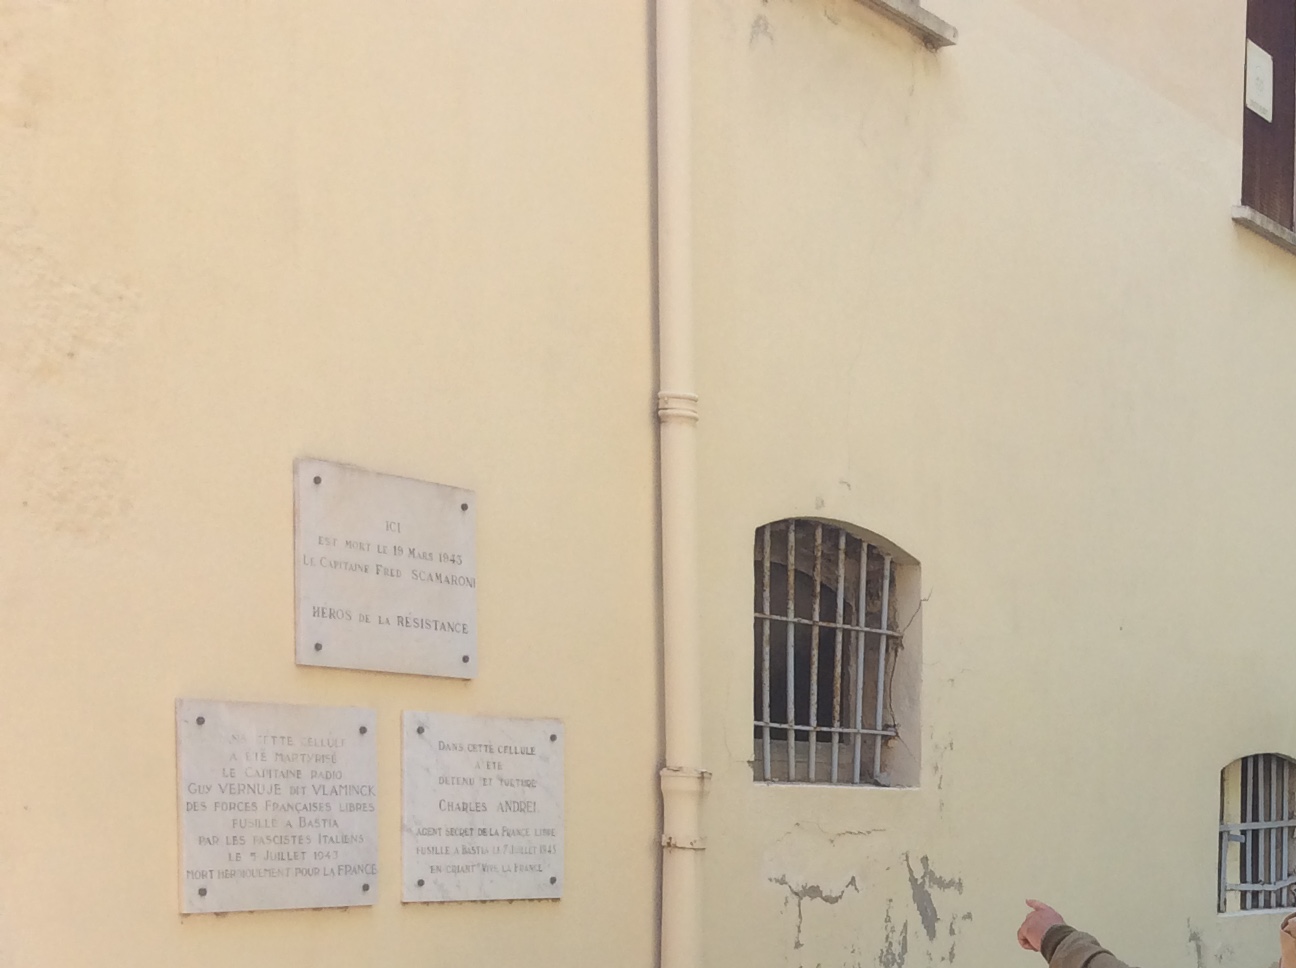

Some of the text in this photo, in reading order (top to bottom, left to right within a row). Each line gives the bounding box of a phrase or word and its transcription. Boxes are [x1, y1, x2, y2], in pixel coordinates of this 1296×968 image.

[385, 520, 401, 533] ICI
[318, 536, 337, 547] EST
[345, 540, 370, 552] MORT
[377, 545, 388, 554] LE
[393, 545, 404, 556] 19
[303, 554, 316, 566] LE
[320, 557, 370, 574] CAPITAINE
[411, 569, 476, 589] SCAMARONI
[359, 613, 371, 623] DE
[378, 615, 391, 625] LA
[438, 740, 536, 755] DANS CETTE CELLULE
[222, 769, 235, 778] LE
[311, 770, 343, 780] RADIO
[290, 786, 306, 795] DIT
[312, 785, 376, 796] VLAMINCK
[186, 800, 375, 814] DES FORCES FRANÇAISES LIBRES
[439, 799, 487, 812] CHARLES
[299, 816, 339, 828] BASTIA
[416, 827, 442, 837] AGENT
[445, 827, 474, 837] SECRET
[489, 828, 499, 836] LA
[198, 833, 364, 846] PAR LES FASCISTES ITALIENS
[228, 852, 241, 861] LE
[264, 851, 306, 861] JUILLET
[186, 870, 214, 880] MORT
[295, 867, 320, 877] POUR
[323, 866, 335, 876] LA
[338, 864, 378, 876] FRANCE
[430, 865, 442, 873] EN
